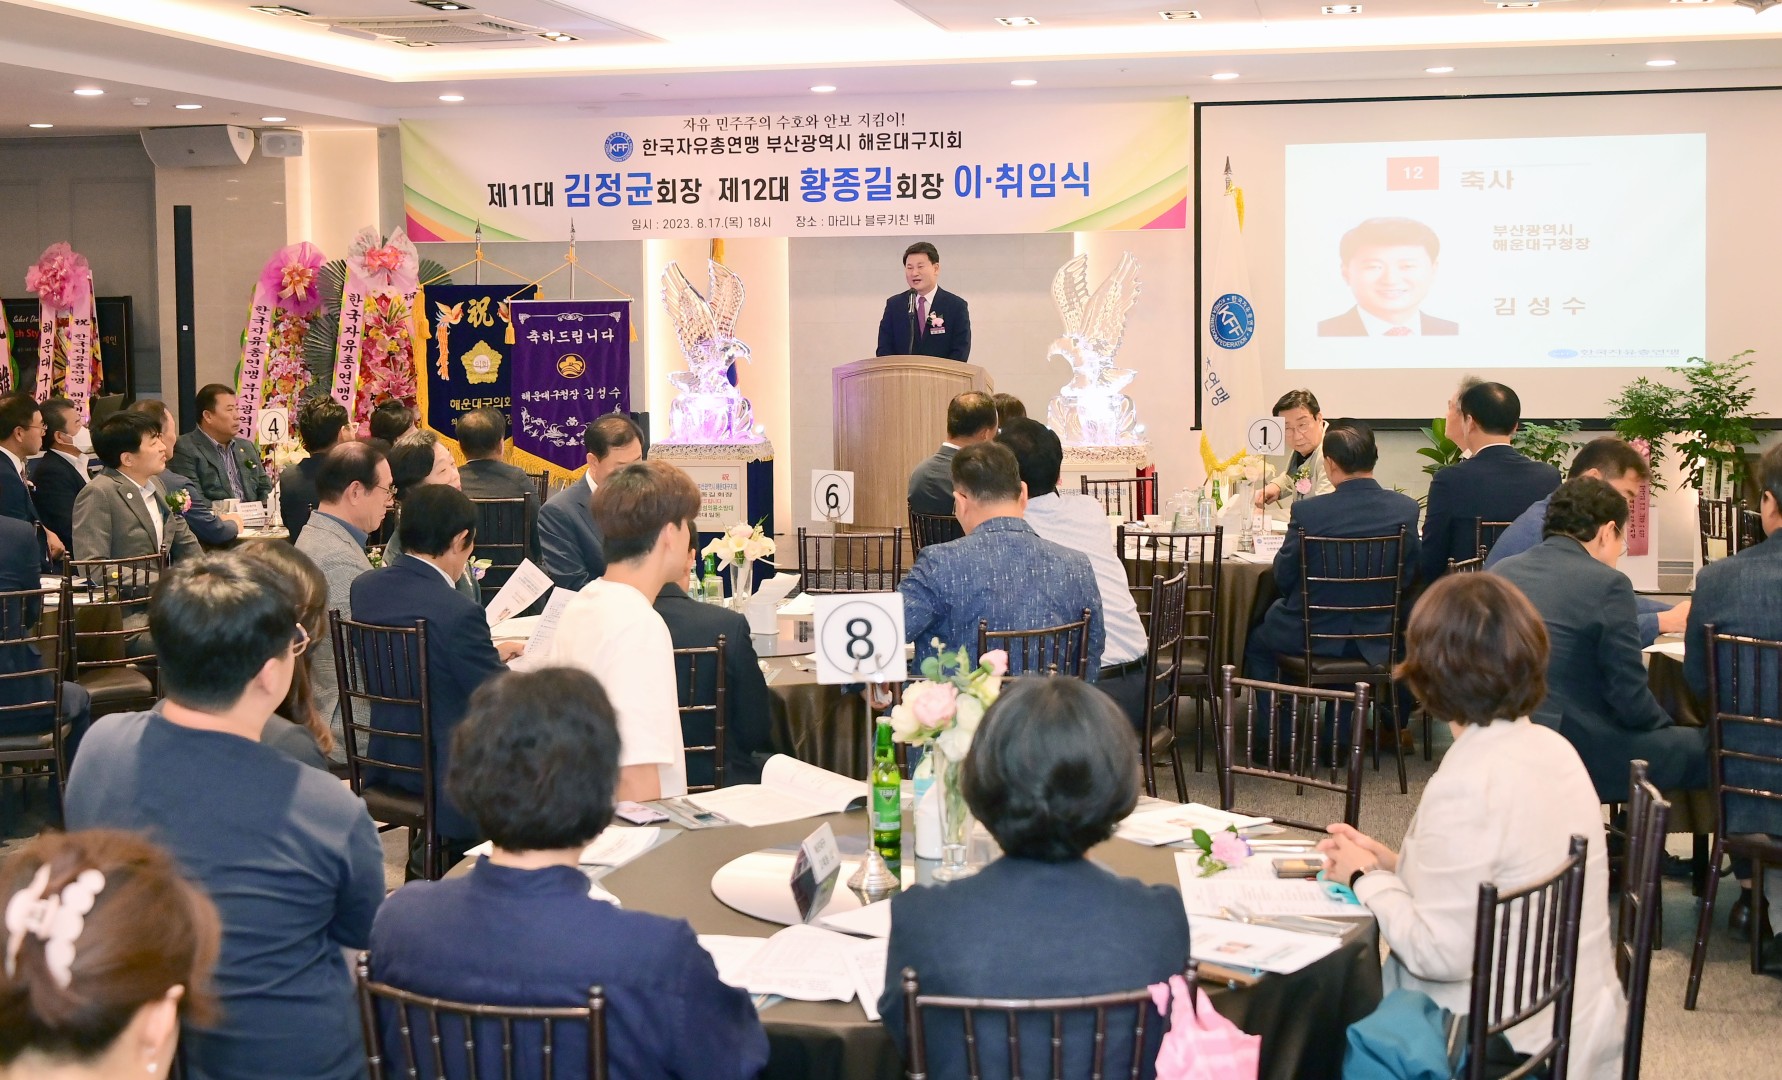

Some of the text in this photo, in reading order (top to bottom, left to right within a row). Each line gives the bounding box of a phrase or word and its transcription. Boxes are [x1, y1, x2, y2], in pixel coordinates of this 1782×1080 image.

[682, 112, 906, 132] 자유 민주주의 수호와 안보 지킴이!
[610, 143, 628, 153] KFF
[642, 135, 760, 156] 한국자유총연맹
[766, 133, 851, 154] 부산광역시
[858, 131, 963, 151] 해운대구지회
[1402, 166, 1425, 180] 12
[1460, 169, 1515, 191] 축사
[487, 181, 554, 208] 제11대
[718, 175, 789, 203] 제12대
[953, 161, 1091, 199] 이·취임식
[631, 217, 653, 231] 일시
[662, 218, 694, 230] 2023.
[748, 217, 772, 230] 18시
[795, 215, 818, 228] 장소
[828, 214, 862, 228] 마리나
[864, 214, 910, 227] 블루키친
[913, 213, 936, 227] 뷔페
[1493, 223, 1574, 237] 부산광역시
[1492, 237, 1591, 252] 해운대구청장
[467, 296, 495, 328] 祝
[1218, 304, 1244, 336] KFF
[26, 328, 39, 340] Sty
[526, 328, 615, 345] 축하드립니다
[336, 293, 364, 402] 한국자유총연맹
[238, 305, 271, 438] 한국자유총연맹 부산광역시
[449, 396, 512, 411] 해운대구의회
[520, 388, 580, 402] 해운대구청장
[267, 417, 280, 435] 4
[1259, 426, 1268, 446] 1
[825, 483, 840, 509] 6
[846, 617, 875, 660] 8
